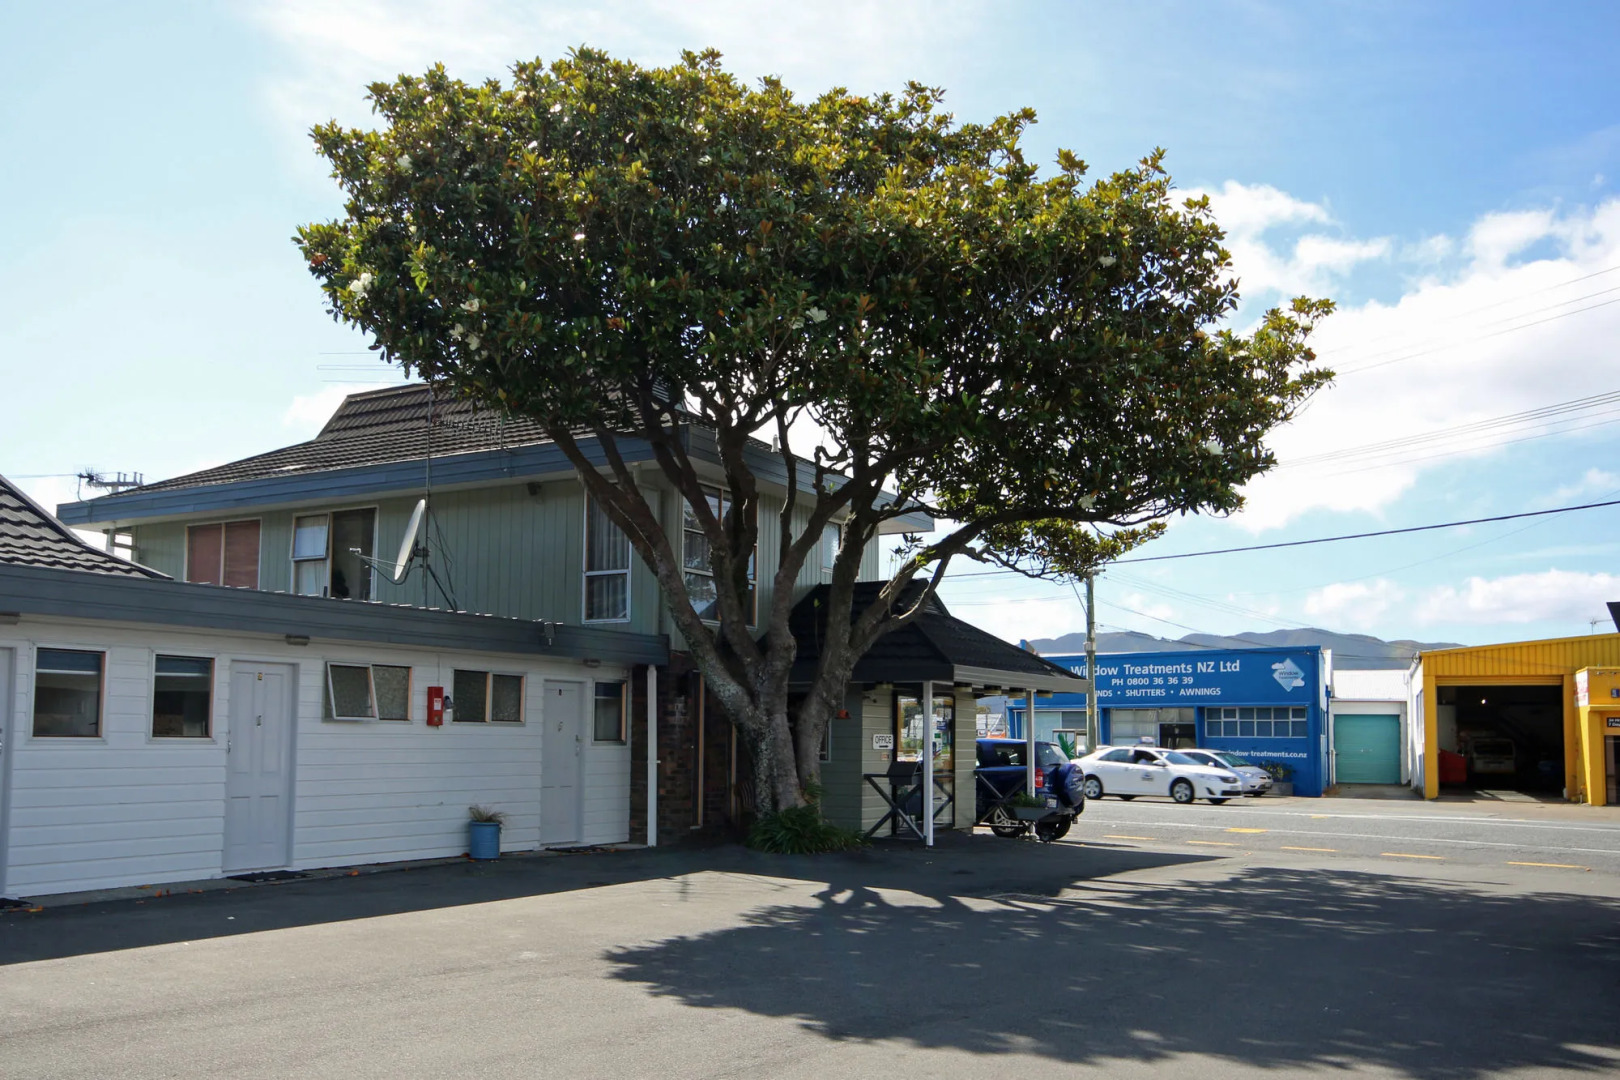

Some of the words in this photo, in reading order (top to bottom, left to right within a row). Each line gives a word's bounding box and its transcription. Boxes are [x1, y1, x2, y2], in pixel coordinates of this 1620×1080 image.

[1070, 664, 1118, 676] Widow
[1123, 662, 1192, 675] Treatments
[1197, 661, 1215, 673] NZ
[1220, 659, 1240, 672] Ltd
[1111, 678, 1124, 686] PH
[1127, 677, 1149, 686] 0800
[1153, 677, 1164, 685] 36
[1167, 676, 1178, 685] 36
[1182, 676, 1193, 685] 39
[1125, 688, 1166, 697] SHUTTERS
[1179, 687, 1221, 696] AWNINGS
[875, 735, 892, 744] OFFICE
